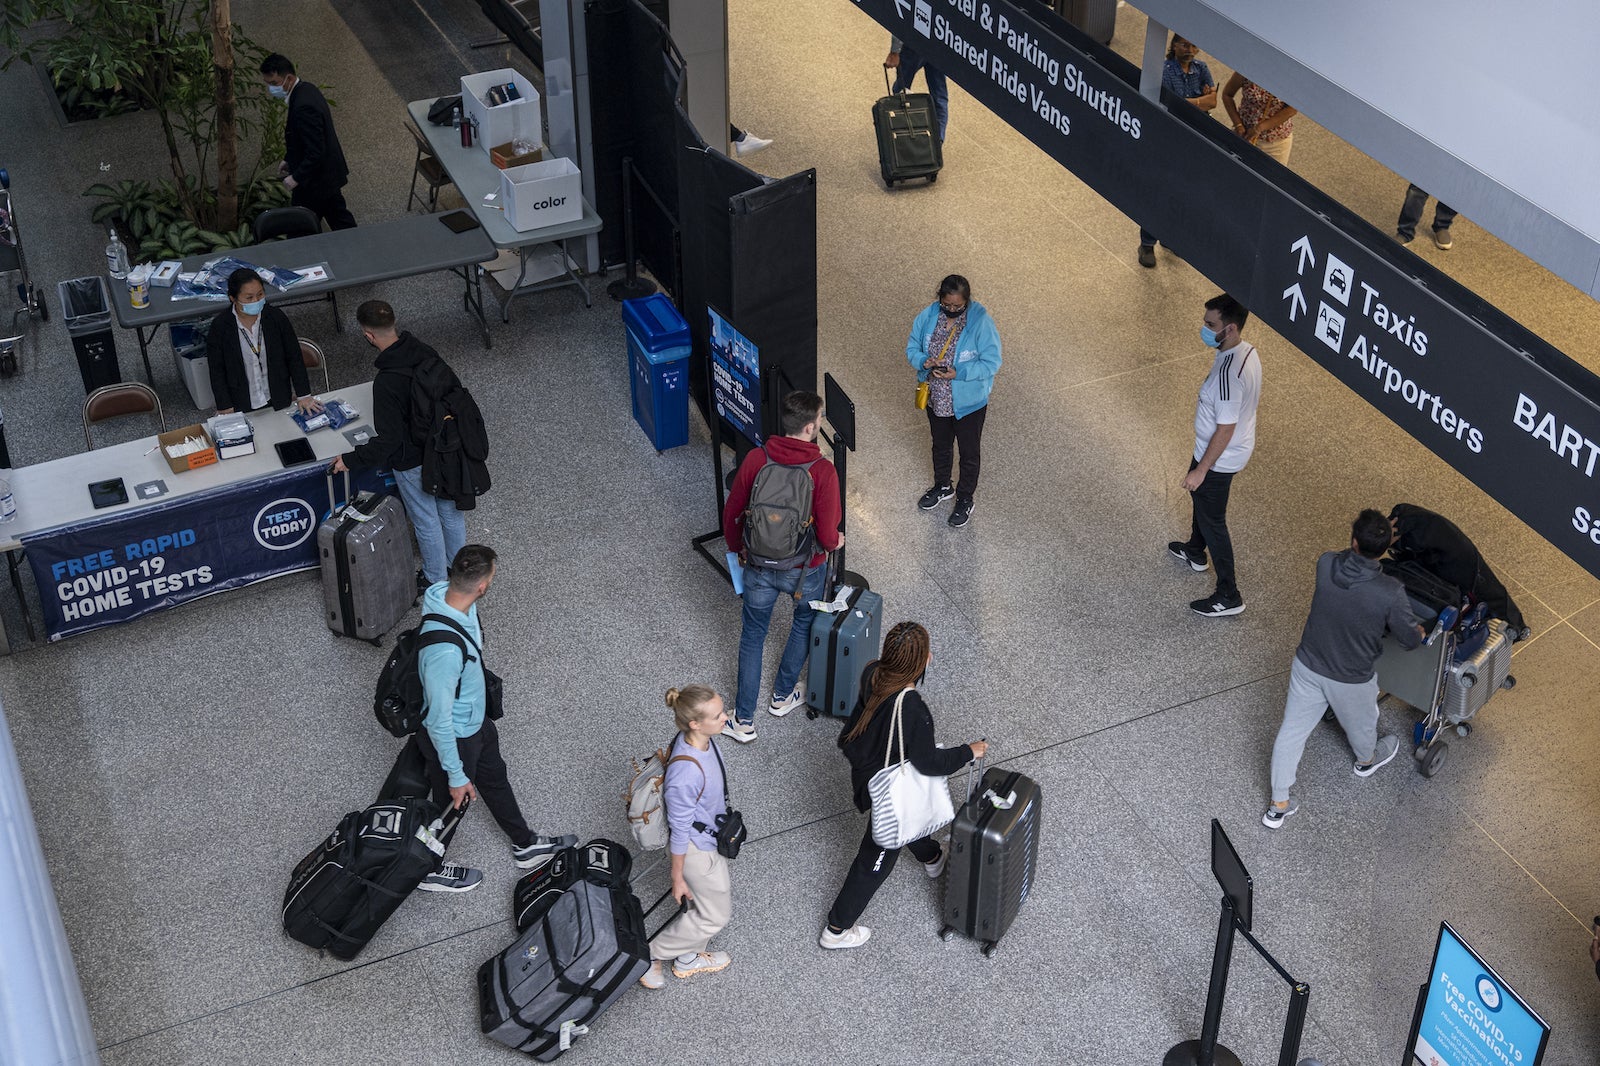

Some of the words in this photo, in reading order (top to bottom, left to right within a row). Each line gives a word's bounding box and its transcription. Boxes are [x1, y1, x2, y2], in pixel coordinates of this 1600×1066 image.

[934, 14, 988, 74] Shared
[991, 55, 1026, 104] Ride
[1030, 83, 1071, 136] Vans
[980, 2, 993, 34] &
[998, 14, 1060, 86] Parking
[1063, 62, 1142, 140] Shuttles
[533, 196, 566, 210] color
[1320, 308, 1327, 322] A
[1360, 280, 1429, 357] Taxis
[732, 388, 755, 413] TESTS
[1348, 334, 1485, 454] Airporters
[1513, 392, 1600, 478] BART
[261, 517, 309, 539] TODAY
[265, 508, 300, 524] TEST
[51, 550, 116, 581] FREE
[125, 529, 196, 561] RAPID
[57, 557, 165, 602] COVID-19
[62, 586, 133, 622] HOME
[136, 565, 214, 600] TESTS
[1441, 972, 1465, 1003] Free
[1467, 1000, 1523, 1061] COVID-19
